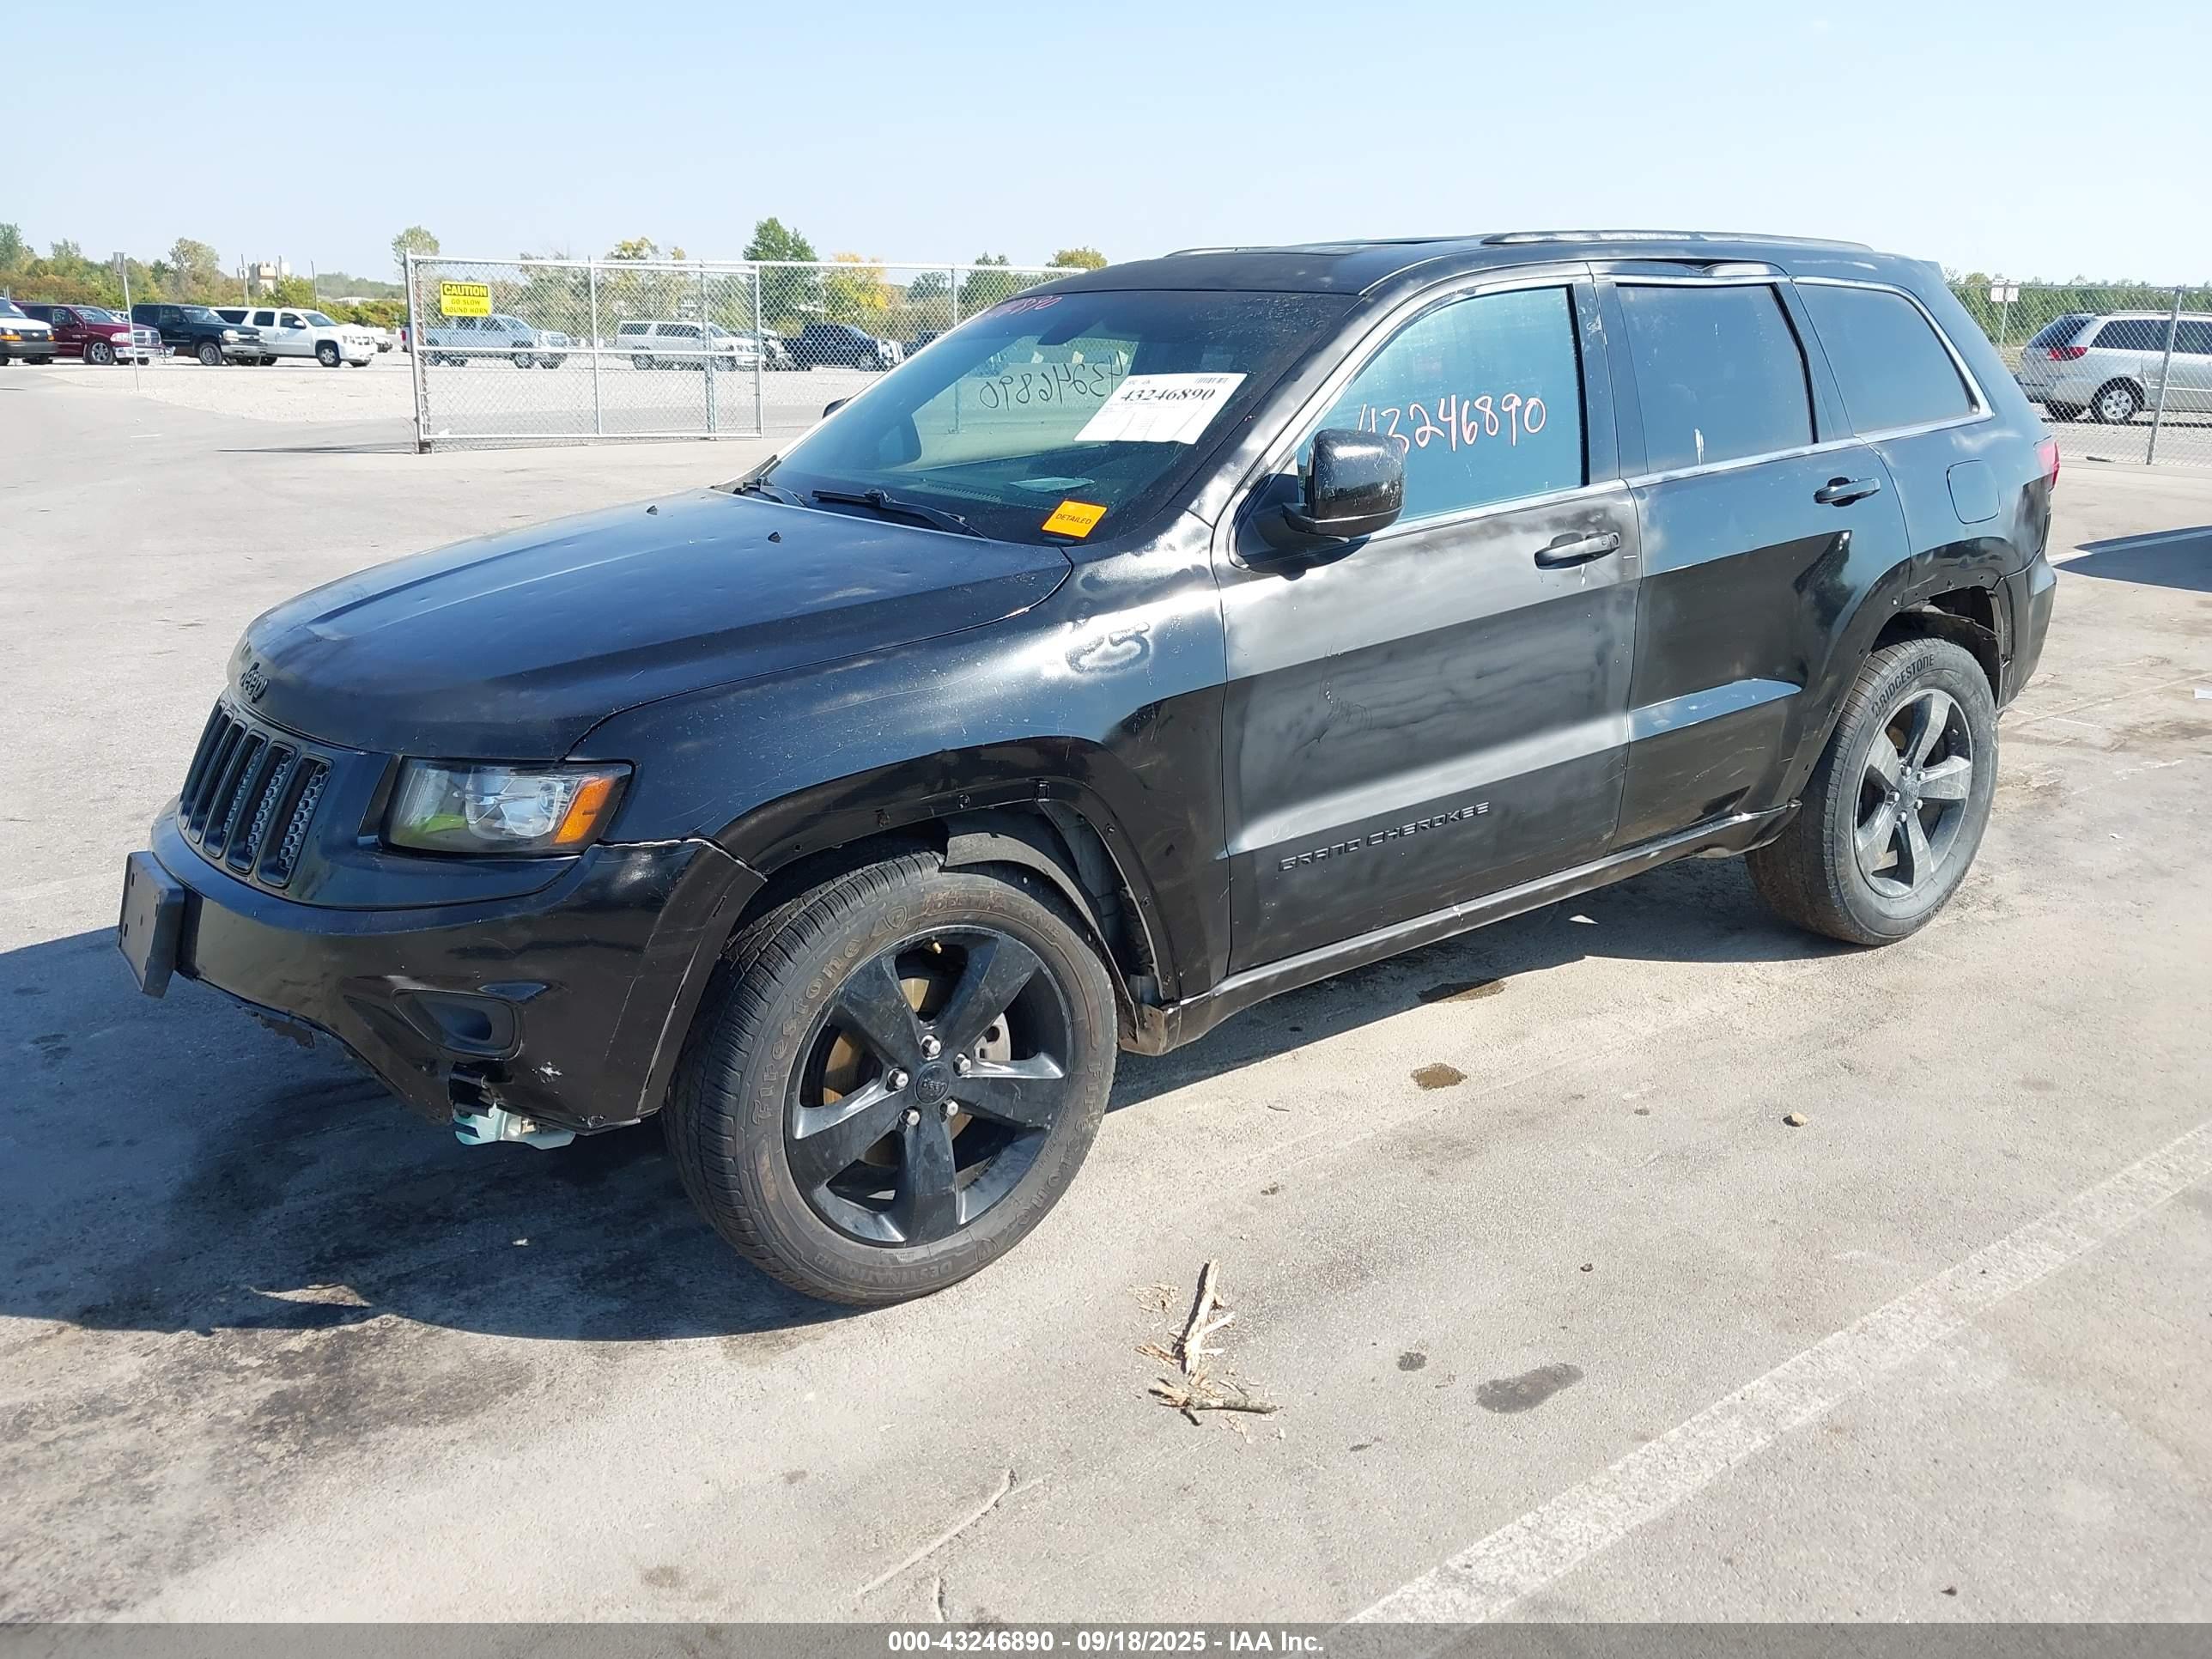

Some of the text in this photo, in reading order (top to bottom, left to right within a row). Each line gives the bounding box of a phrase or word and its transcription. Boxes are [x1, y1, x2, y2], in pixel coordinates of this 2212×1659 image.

[444, 285, 487, 296] CAUTION
[1121, 387, 1217, 402] 43246890
[1055, 513, 1092, 525] DETAILED
[1872, 653, 1936, 719] BRIDGESTONE
[1278, 801, 1490, 872] GRAND CHEROKEE
[751, 939, 860, 1126] Firestone
